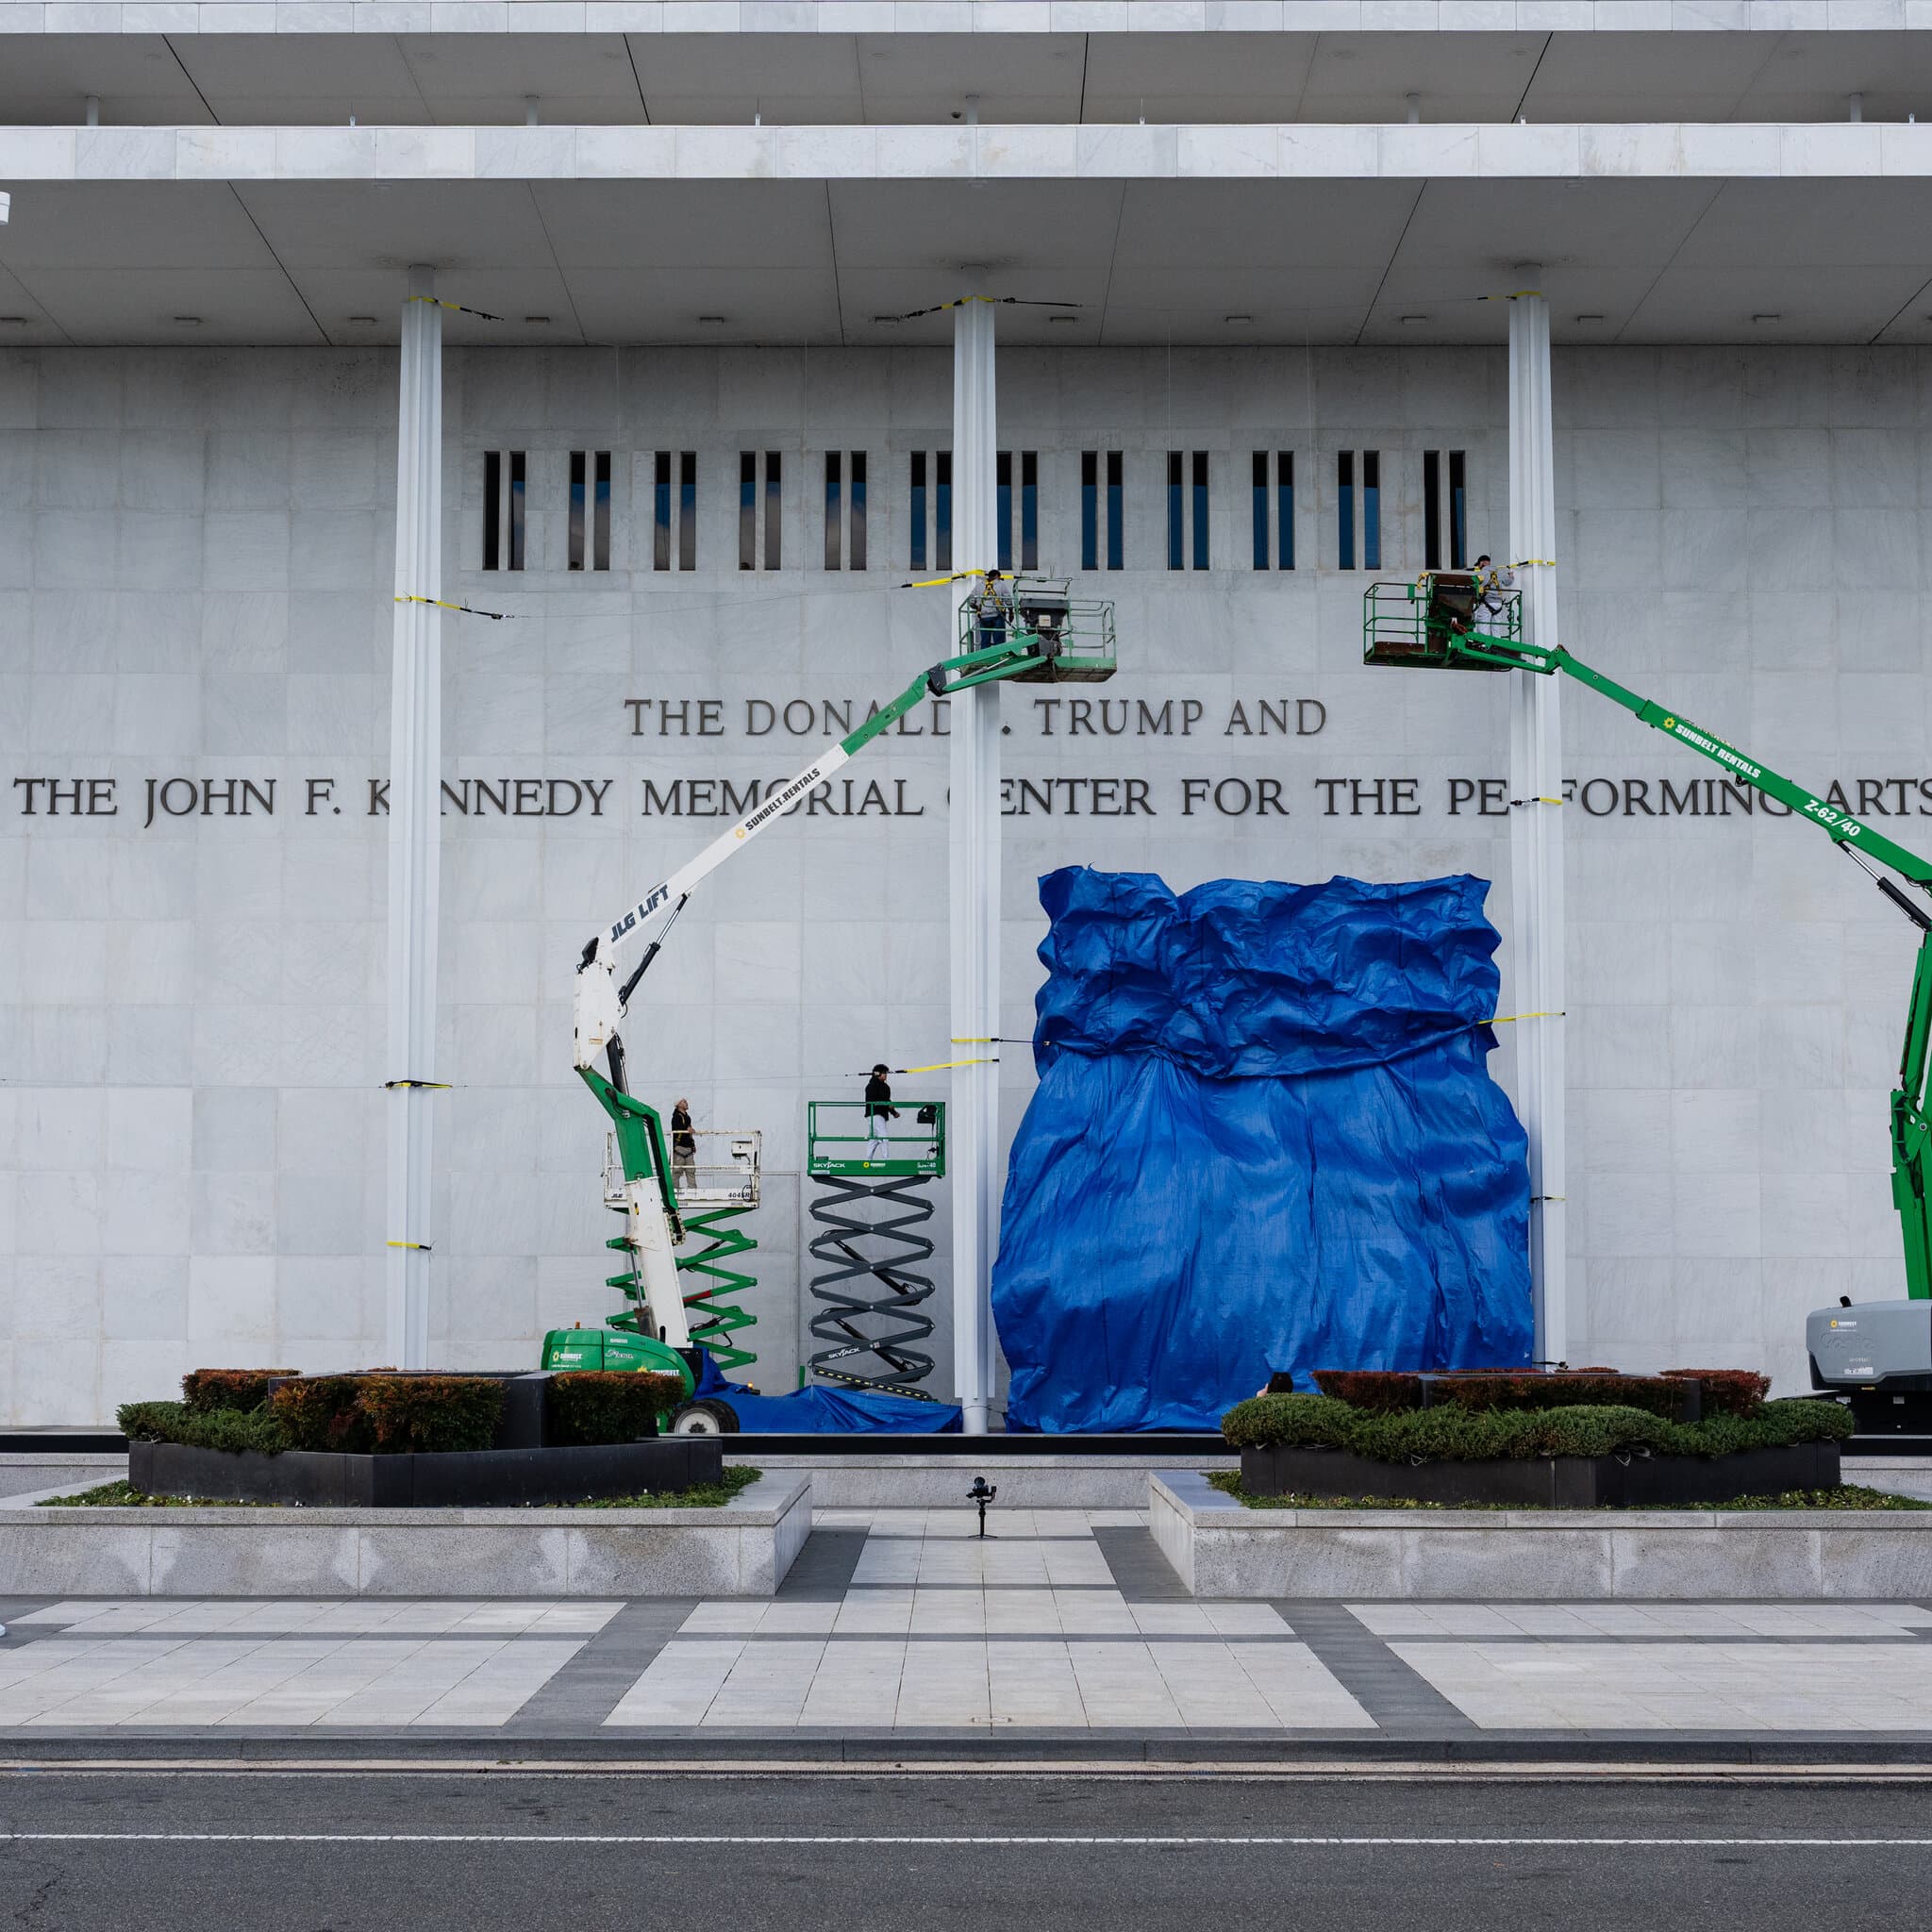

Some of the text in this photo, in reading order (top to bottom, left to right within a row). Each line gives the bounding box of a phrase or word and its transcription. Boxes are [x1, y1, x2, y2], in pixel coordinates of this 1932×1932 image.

[624, 698, 725, 737] THE
[1033, 698, 1205, 737] TRUMP
[1224, 698, 1326, 737] AND
[1674, 723, 1761, 779] SUNBELT RENTALS
[12, 776, 118, 816] THE
[143, 777, 277, 829] JOHN
[305, 778, 341, 816] F.
[366, 778, 615, 817] KNNEDY
[1180, 777, 1291, 817] FOR
[1314, 777, 1423, 817] THE
[1804, 799, 1861, 837] Z-62/40
[610, 883, 669, 943] JLG LIFT
[827, 1347, 861, 1359] SKYJACK
